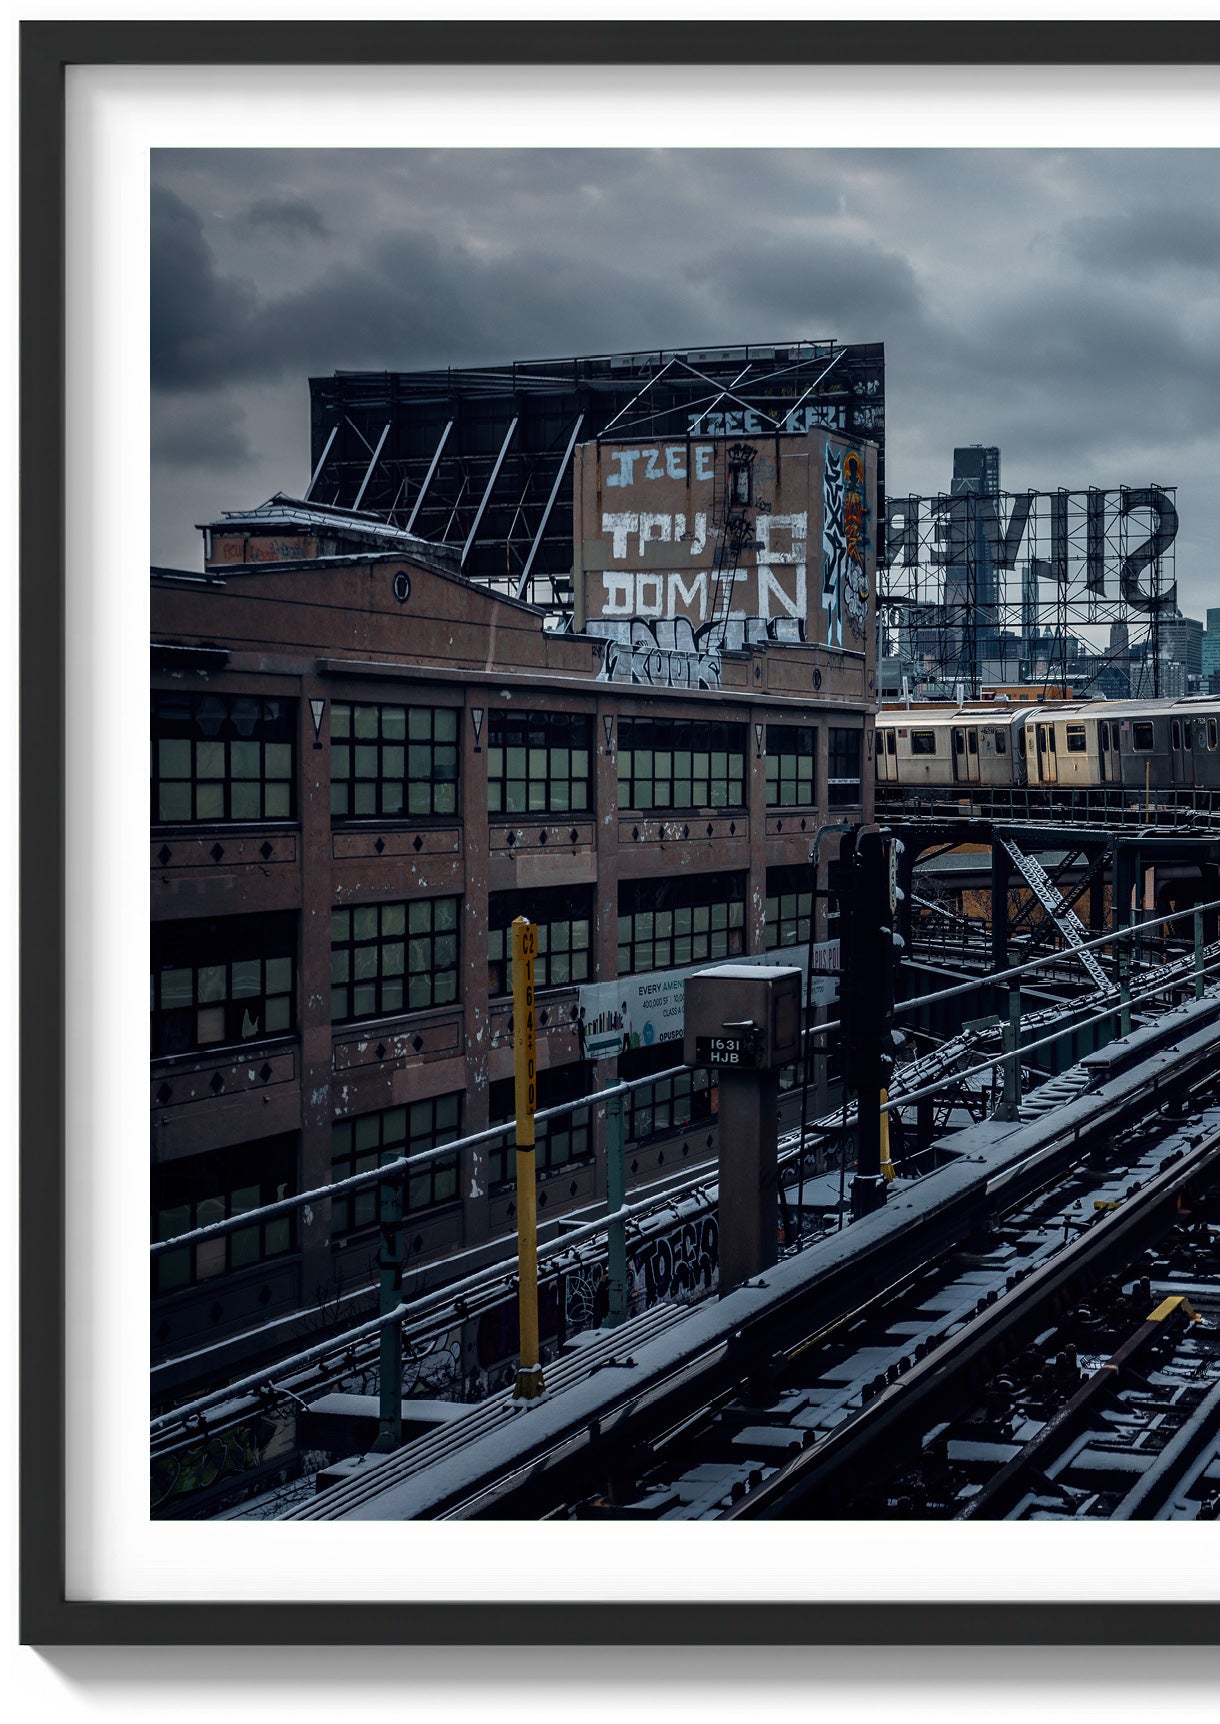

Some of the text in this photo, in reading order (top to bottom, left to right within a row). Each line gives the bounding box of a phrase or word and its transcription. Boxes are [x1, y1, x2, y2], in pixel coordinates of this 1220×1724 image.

[522, 934, 534, 954] C2
[638, 983, 662, 996] EVERY
[711, 1039, 740, 1051] 1631
[710, 1051, 740, 1064] HJB
